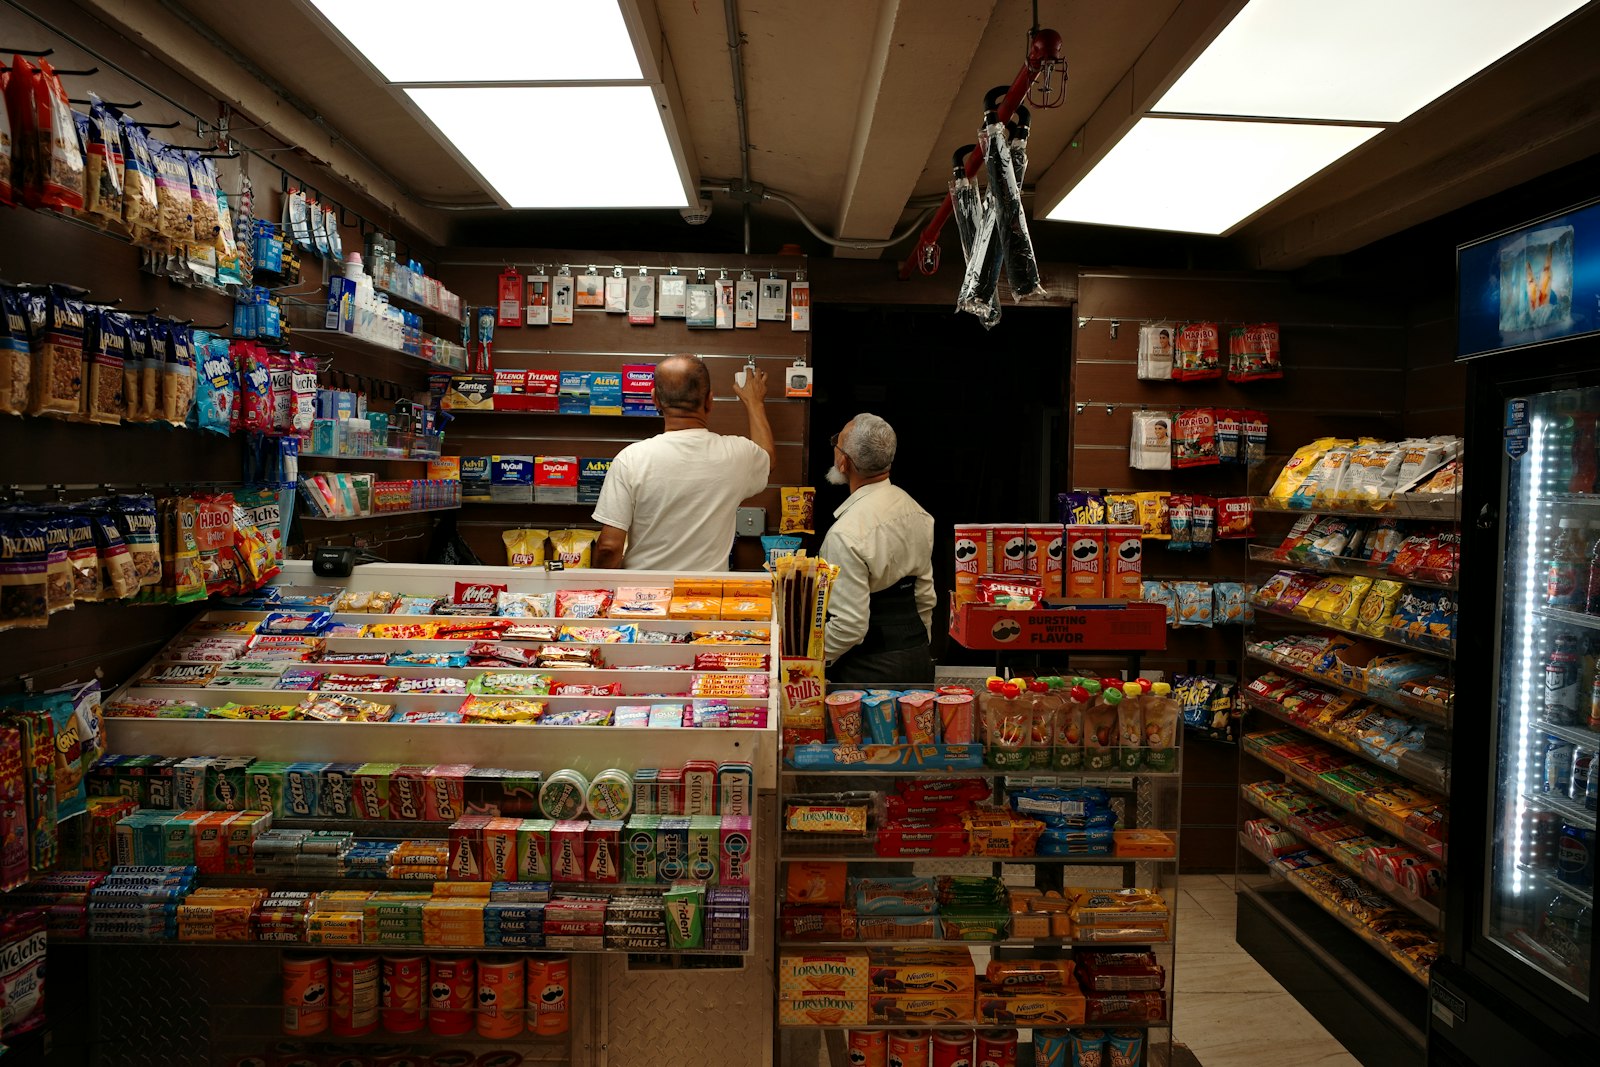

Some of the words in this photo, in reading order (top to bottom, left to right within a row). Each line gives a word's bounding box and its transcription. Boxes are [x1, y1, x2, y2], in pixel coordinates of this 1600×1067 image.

[496, 372, 525, 380] TYLENOL
[528, 373, 558, 381] TYLENOL
[594, 377, 620, 386] ALEVE
[458, 382, 488, 394] Zantac
[463, 460, 485, 468] Advil
[501, 463, 523, 471] NyQuil
[543, 464, 568, 472] DayQuil
[248, 507, 280, 524] elch's
[1073, 505, 1104, 525] Takis
[1, 535, 46, 559] BAZZINI
[1071, 558, 1098, 574] PRINGLES
[815, 590, 825, 629] BIGGEST
[1028, 616, 1087, 625] BURSTING
[1046, 625, 1069, 633] WITH
[1031, 633, 1084, 643] FLAVOR
[160, 665, 213, 678] MUNCH
[401, 677, 466, 692] Skittles
[784, 680, 821, 710] Bull's
[56, 728, 79, 753] CORN
[184, 770, 195, 806] Trident
[218, 773, 234, 810] eclipse
[254, 775, 273, 812] Extra
[290, 772, 309, 814] Extra
[328, 772, 347, 815] Extra
[361, 776, 381, 818] Extra
[399, 776, 417, 819] Extra
[434, 777, 455, 820] Extra
[458, 835, 470, 877] Trident
[495, 834, 507, 874] Trident
[527, 838, 538, 877] Trident
[561, 839, 572, 878] Trident
[596, 837, 608, 879] Trident
[116, 865, 165, 873] mentos
[110, 877, 159, 886] mentos
[93, 901, 144, 909] mentos
[380, 907, 404, 915] HALLS
[629, 910, 660, 919] HALLS
[677, 898, 693, 939] Trident
[324, 920, 347, 928] Ricola
[500, 922, 526, 930] HALLS
[381, 932, 405, 940] HALLS
[627, 927, 659, 935] HALLS
[502, 935, 527, 943] HALLS
[628, 939, 658, 948] HALLS
[793, 964, 825, 977] LORNA
[825, 963, 856, 976] DOONE
[906, 972, 935, 981] Newtons
[1005, 974, 1045, 985] OREO
[792, 997, 824, 1010] LORNA
[824, 997, 855, 1010] DOONE
[906, 1002, 935, 1010] Newtons
[1016, 1002, 1045, 1012] Newtons
